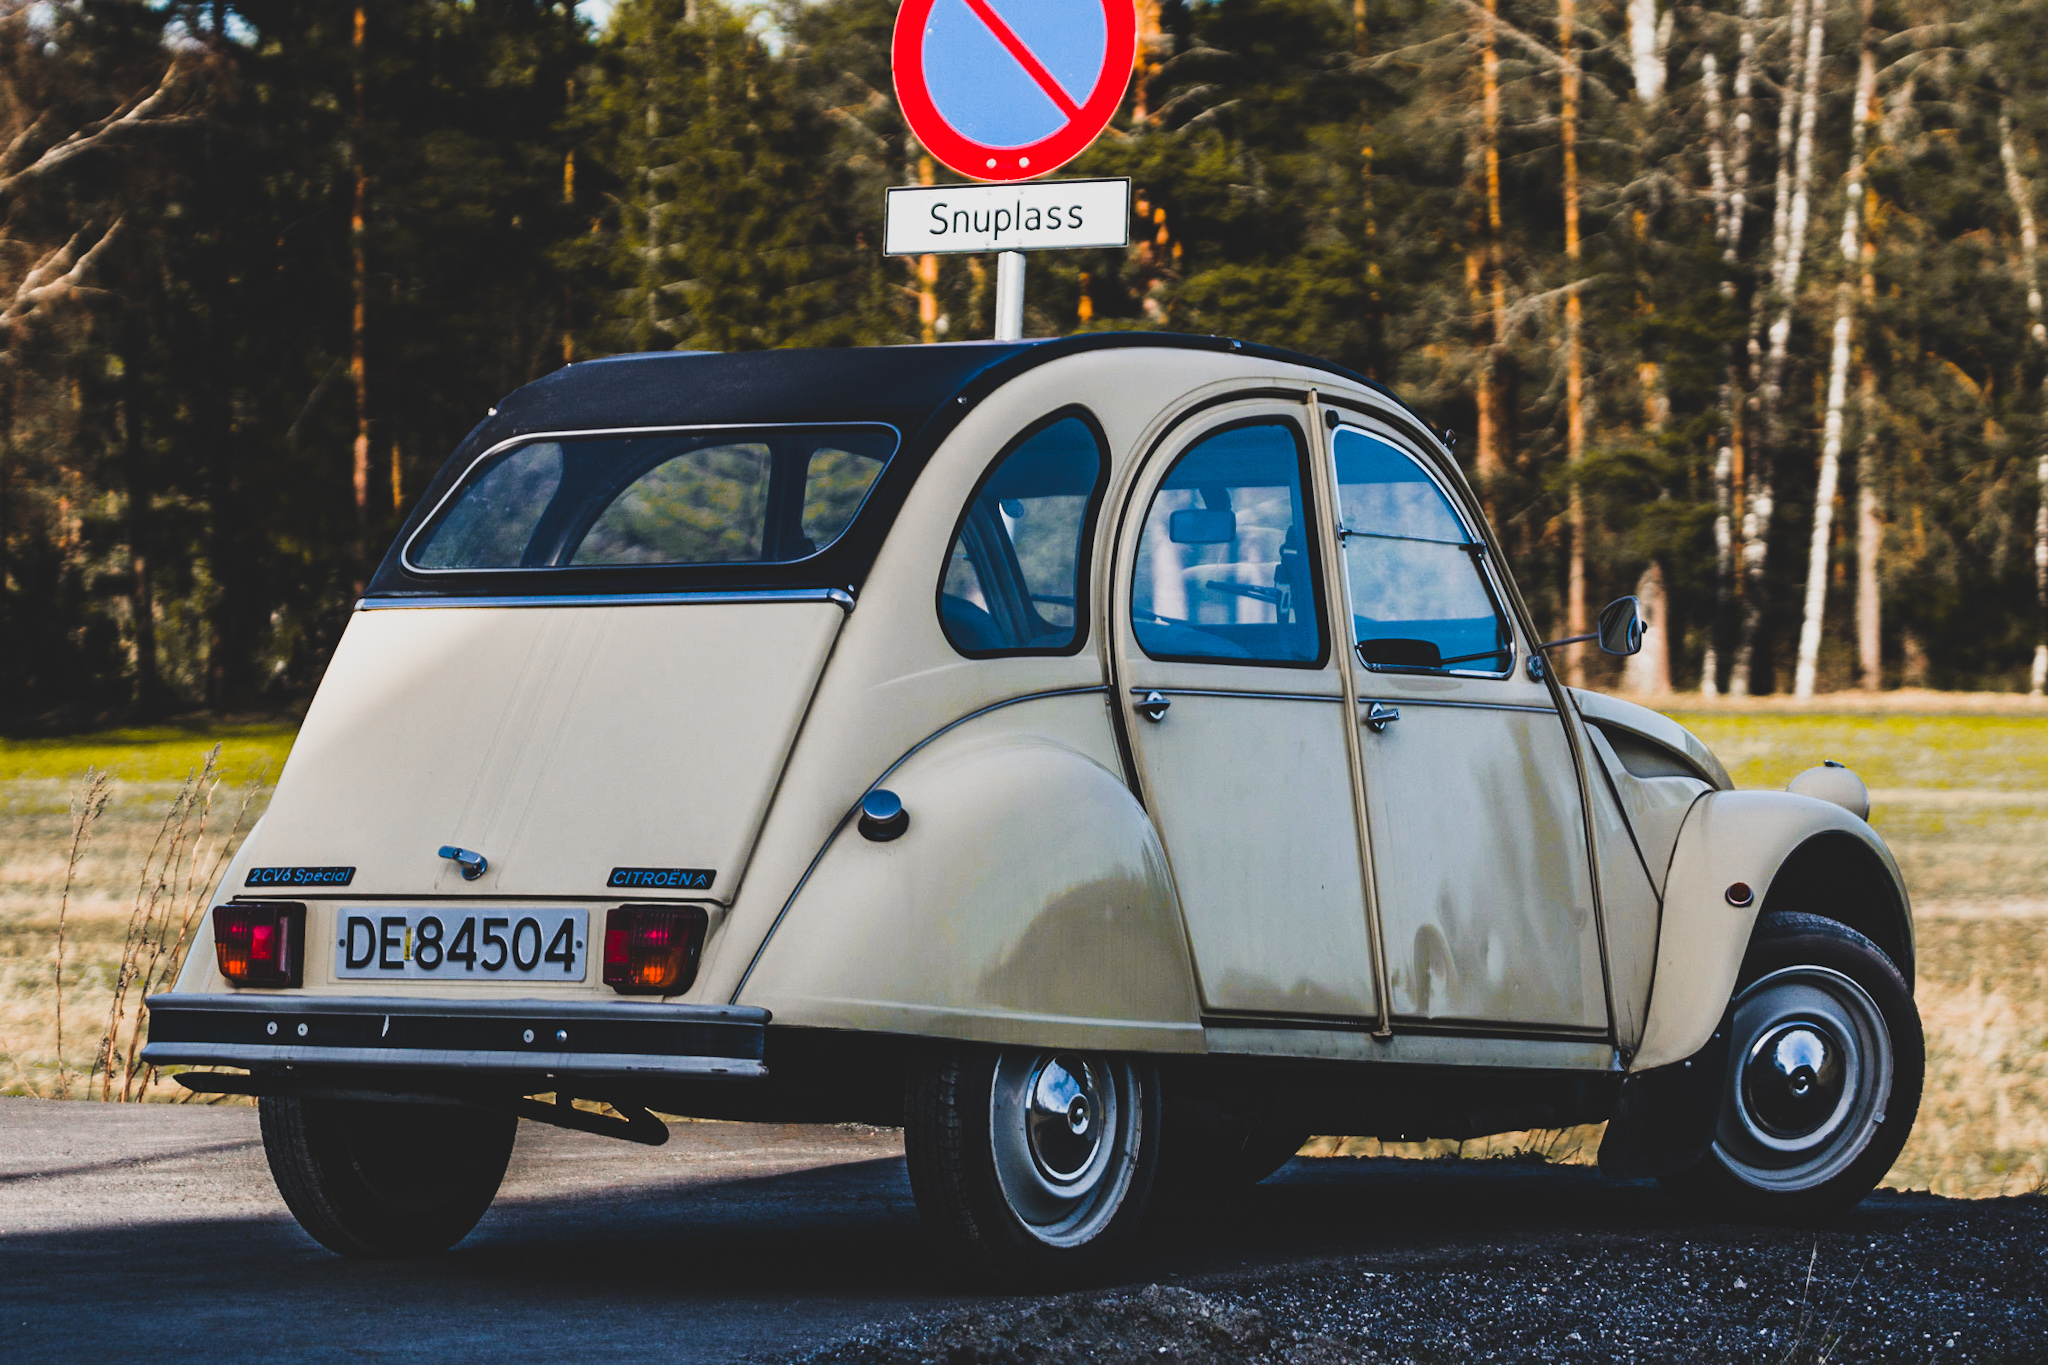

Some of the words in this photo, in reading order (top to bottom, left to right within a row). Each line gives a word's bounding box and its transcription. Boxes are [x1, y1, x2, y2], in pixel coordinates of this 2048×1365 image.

[929, 199, 1084, 241] Snuplass
[250, 868, 293, 883] 2CV6
[612, 869, 694, 886] CITROËN
